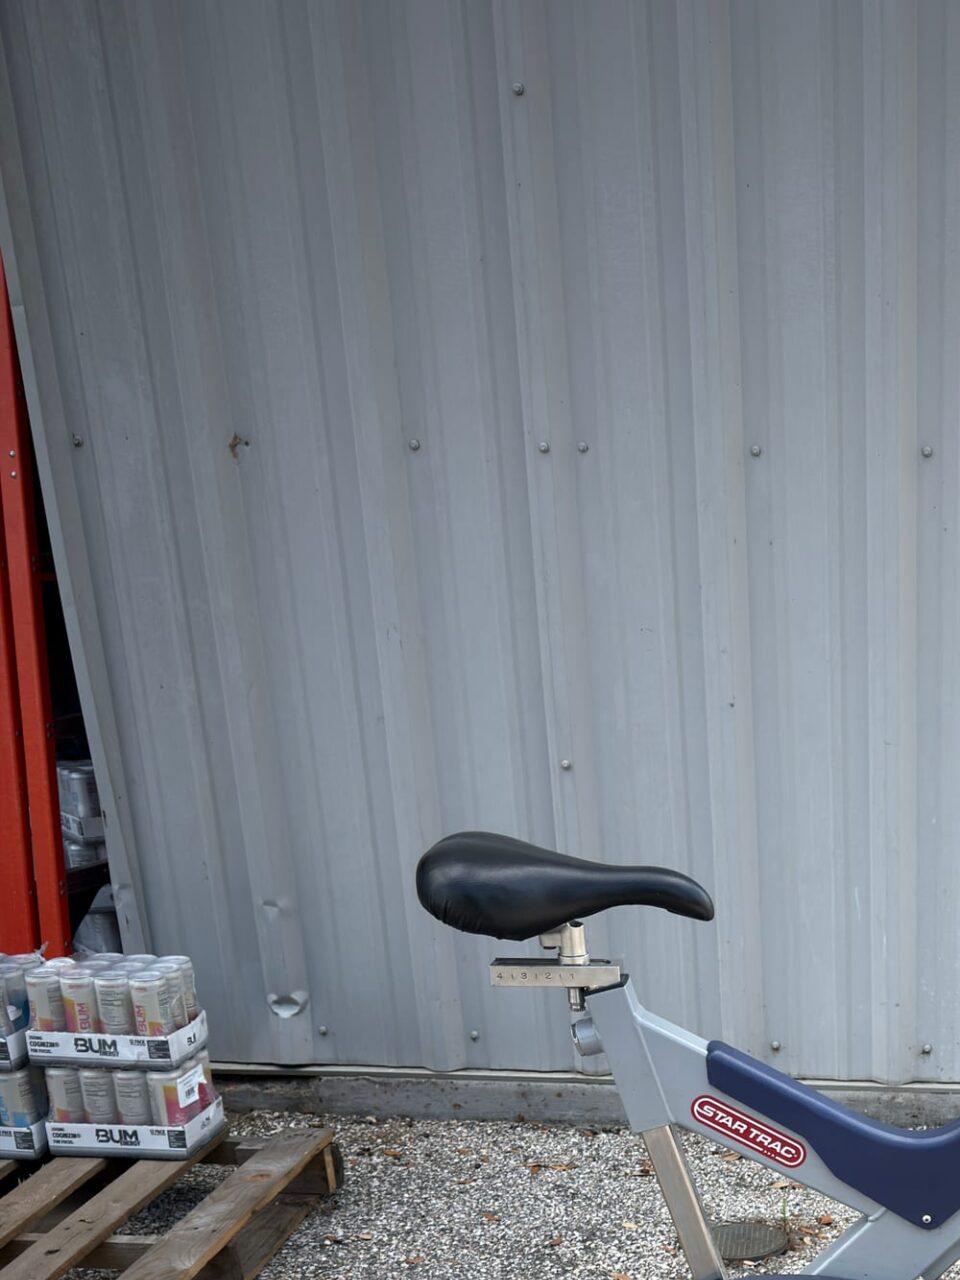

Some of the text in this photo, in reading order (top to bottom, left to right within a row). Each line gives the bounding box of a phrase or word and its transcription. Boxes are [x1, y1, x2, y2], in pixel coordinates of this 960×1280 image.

[496, 972, 503, 980] 4
[520, 972, 528, 980] 3
[544, 972, 552, 980] 2
[74, 1037, 118, 1054] BUM
[95, 1128, 139, 1144] BUM
[699, 1104, 797, 1158] STAR TRAC
